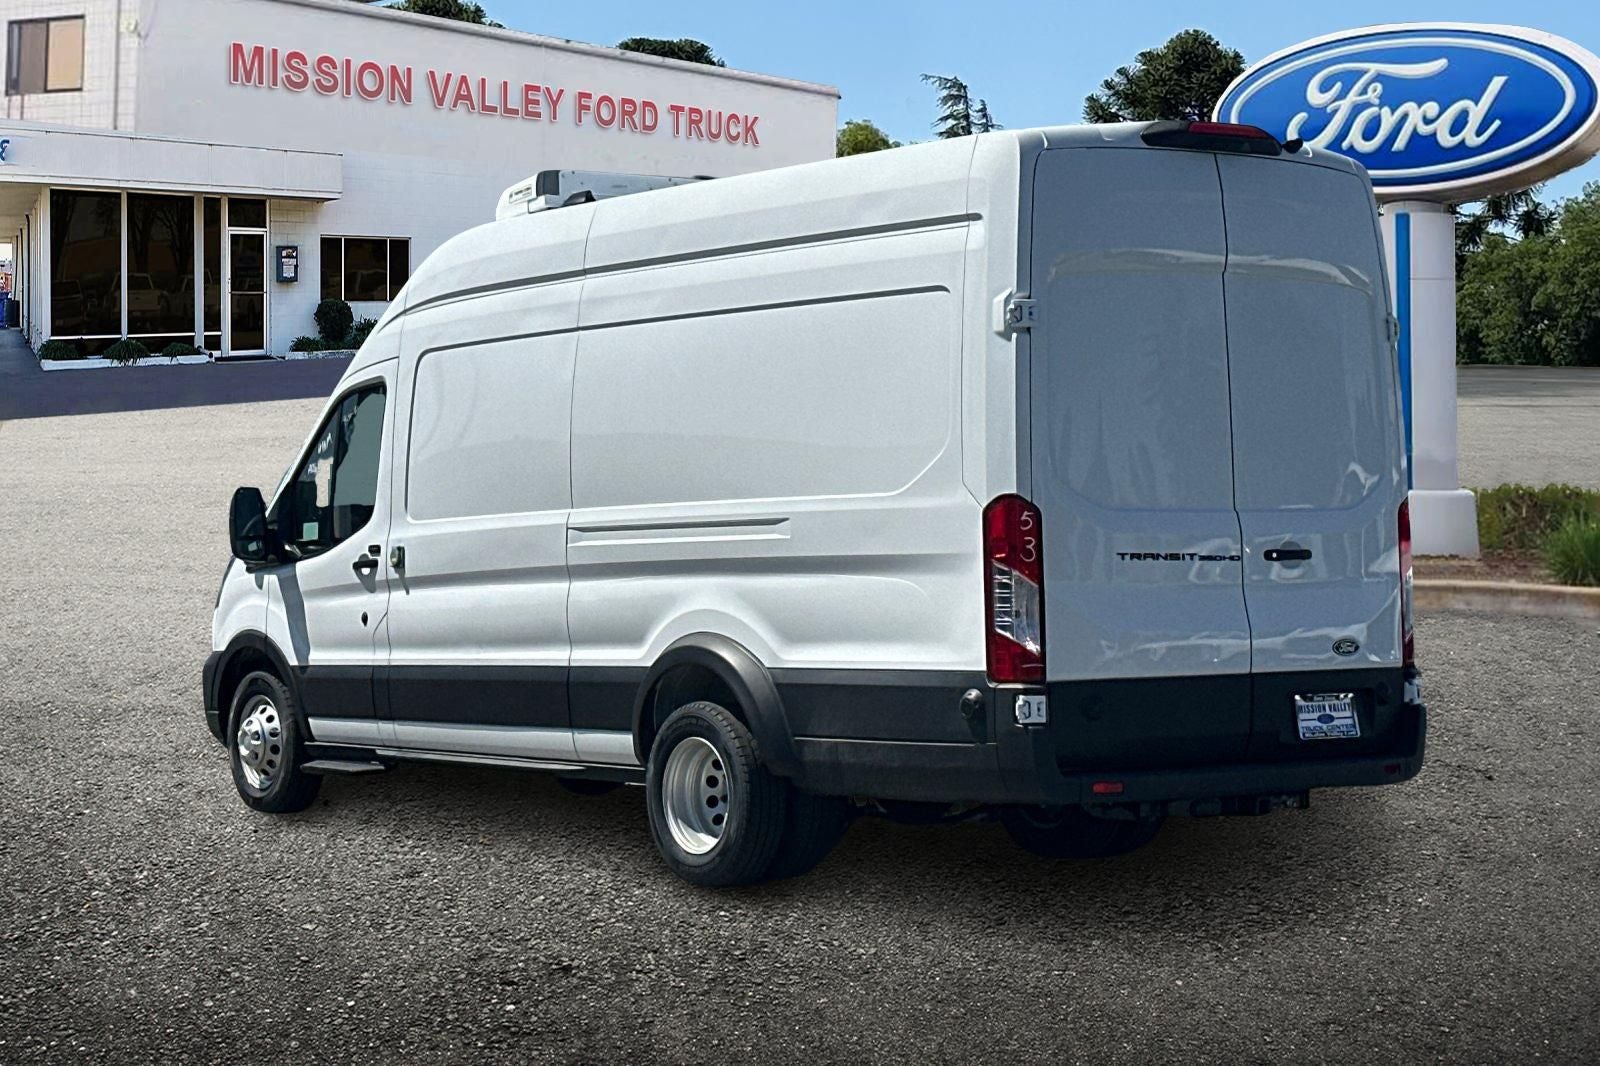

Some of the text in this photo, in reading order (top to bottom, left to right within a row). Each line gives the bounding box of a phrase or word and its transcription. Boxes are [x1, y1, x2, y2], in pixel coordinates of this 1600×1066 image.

[231, 41, 760, 146] MISSION VALLEY FORD TRUCK
[1286, 58, 1509, 153] Ford
[1116, 552, 1197, 561] TRANSIT
[1298, 702, 1351, 713] MISSION VALLEY
